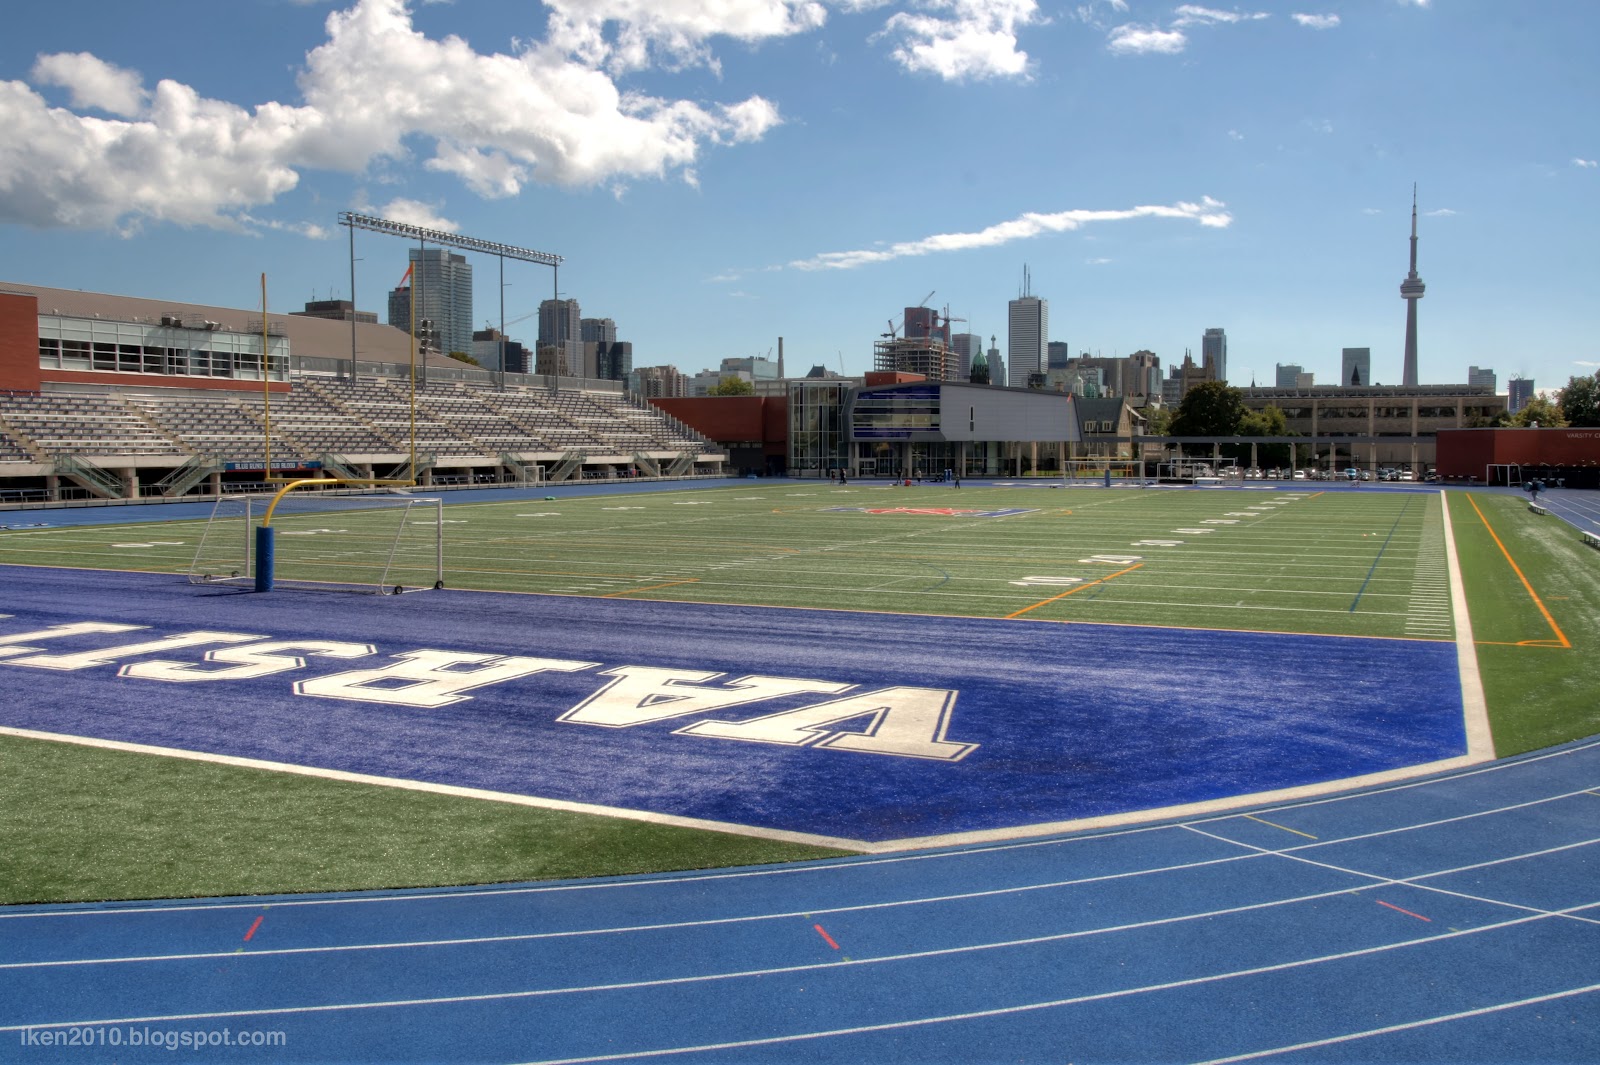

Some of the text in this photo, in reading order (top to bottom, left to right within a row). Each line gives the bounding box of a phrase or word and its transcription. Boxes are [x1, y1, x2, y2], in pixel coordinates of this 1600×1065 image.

[1077, 554, 1143, 565] 20
[1007, 576, 1083, 586] 10
[0, 614, 981, 762] VARSIT
